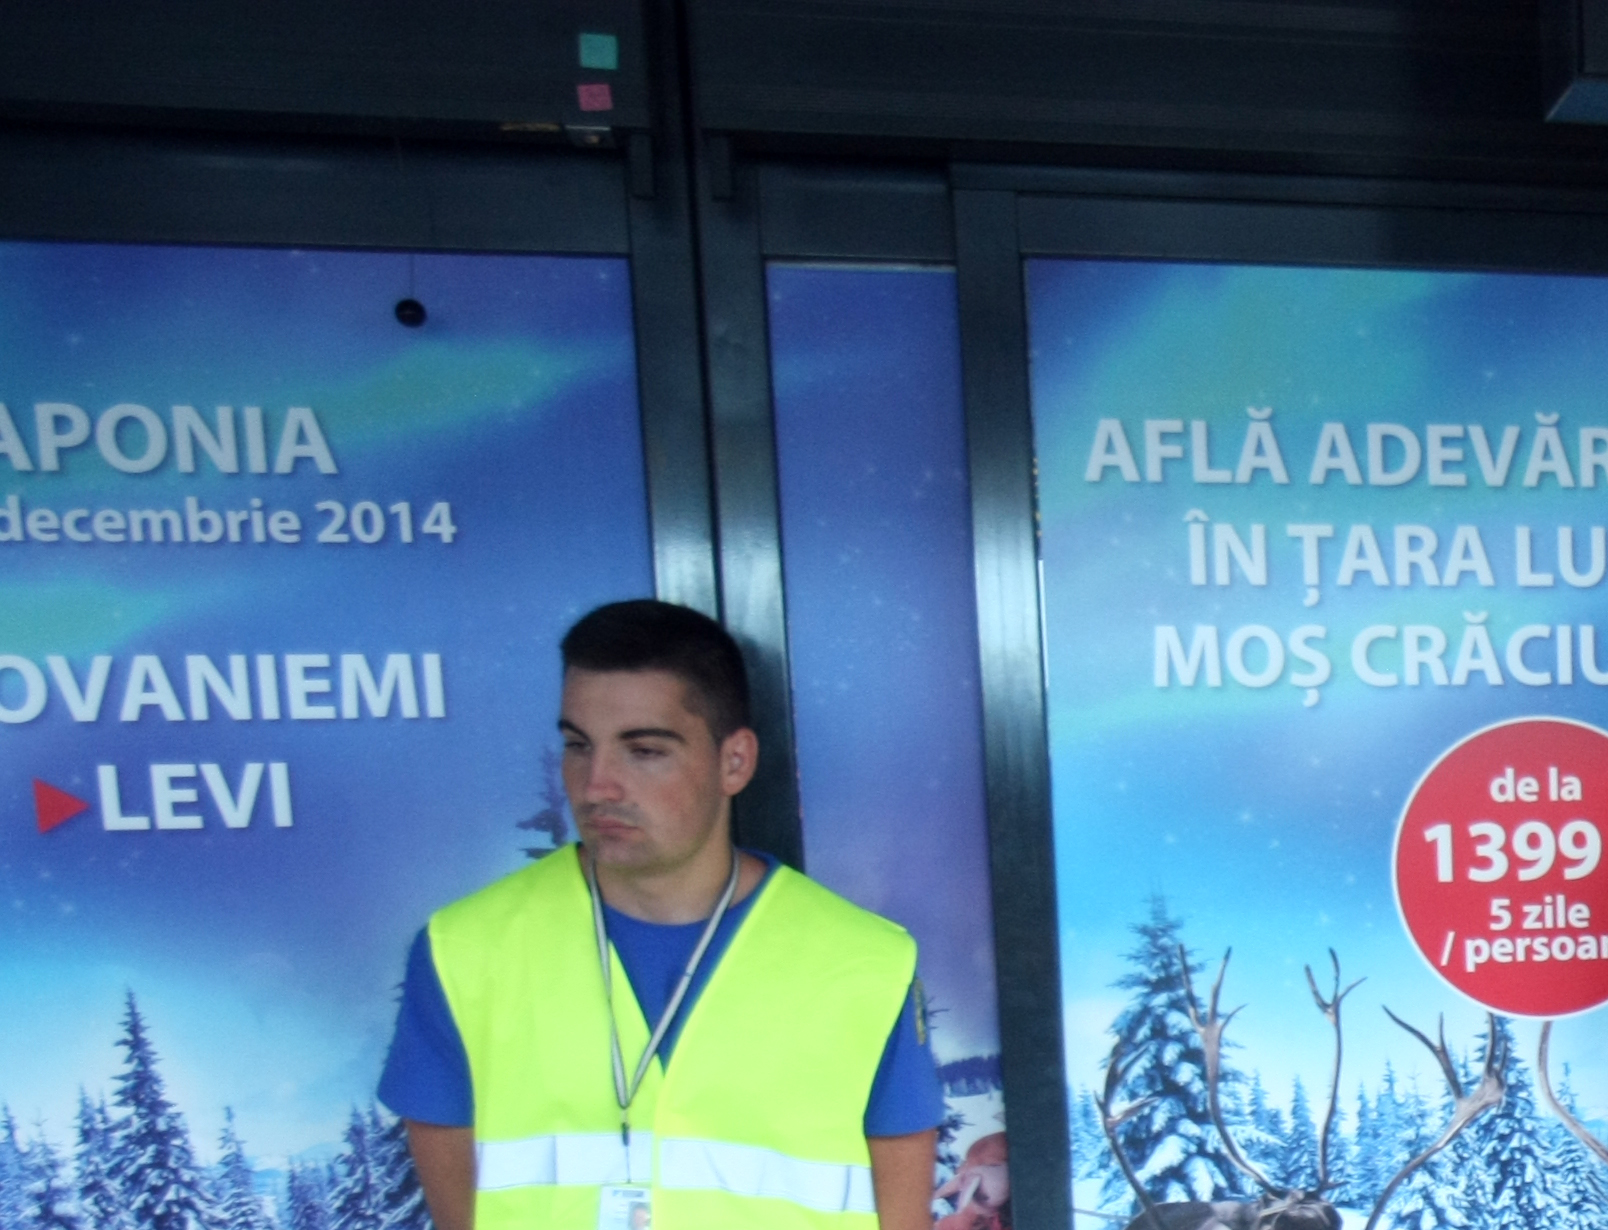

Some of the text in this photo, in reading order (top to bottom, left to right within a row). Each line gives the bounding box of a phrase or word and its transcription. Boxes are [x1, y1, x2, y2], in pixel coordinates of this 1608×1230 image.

[1084, 406, 1289, 484] AFLĂ
[0, 495, 457, 543] decembrie 2014
[1184, 508, 1268, 586] ÎN
[1286, 523, 1495, 606] ȚARA
[0, 652, 446, 724] OVANIEMI
[1153, 624, 1331, 707] MOȘ
[97, 762, 294, 832] LEVI
[1489, 766, 1582, 802] de la
[1489, 894, 1590, 931] 5 zile
